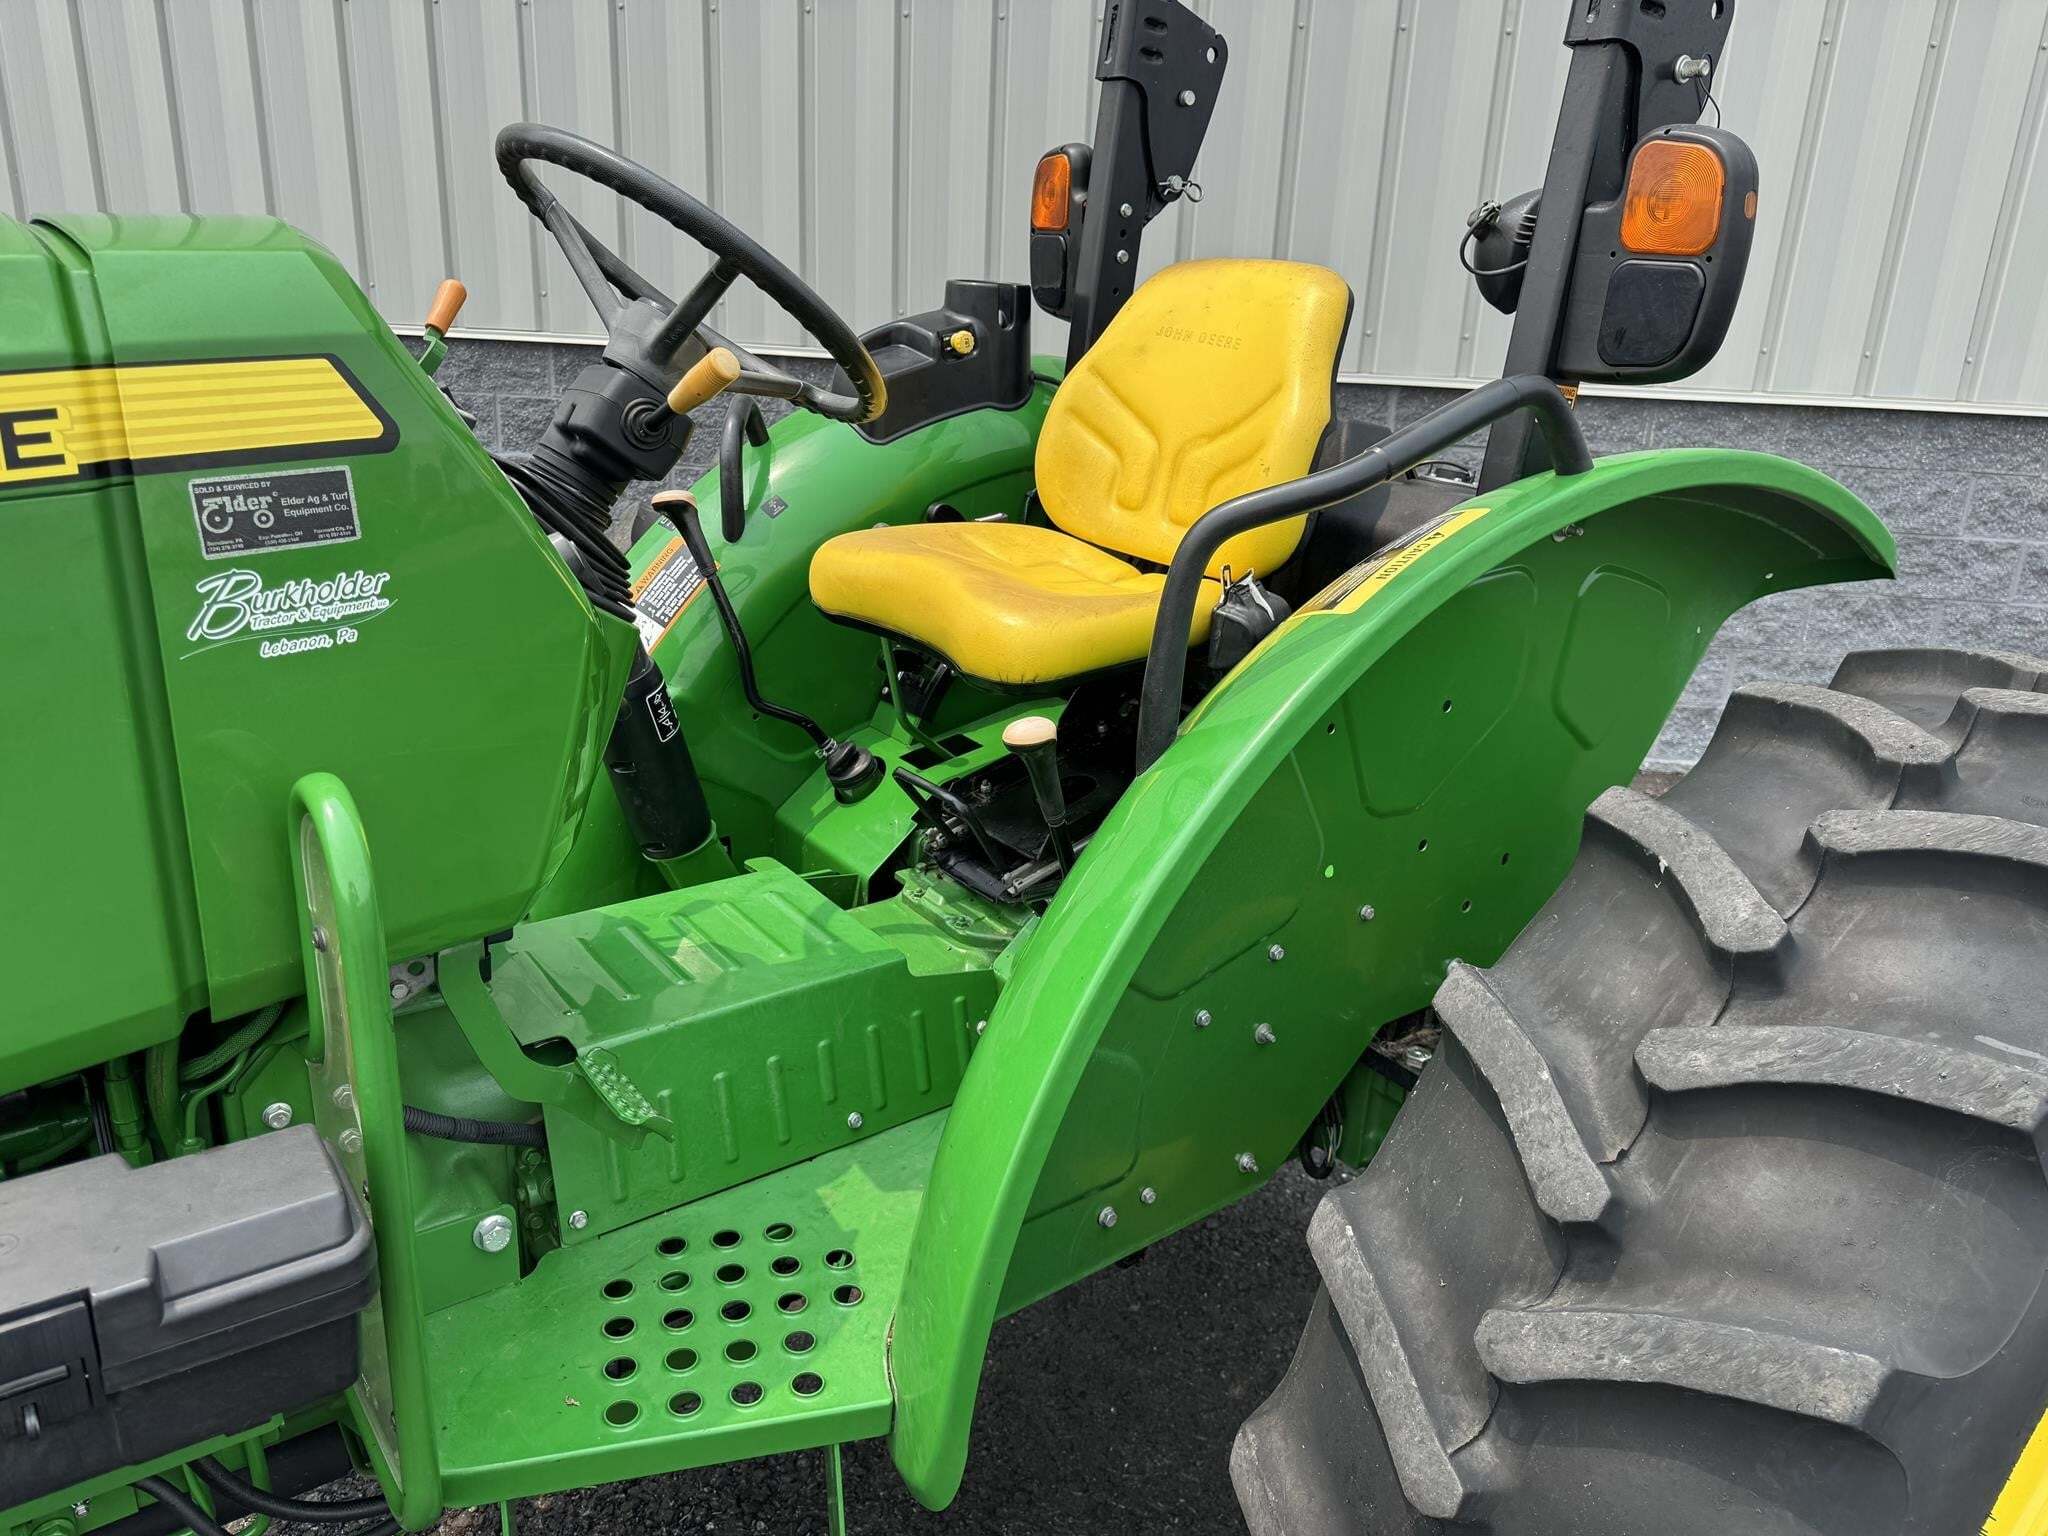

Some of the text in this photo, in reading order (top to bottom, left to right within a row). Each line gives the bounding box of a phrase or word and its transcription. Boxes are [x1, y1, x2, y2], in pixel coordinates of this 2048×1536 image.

[1199, 332, 1242, 350] DEERE
[193, 485, 215, 494] SOLD
[223, 482, 260, 492] SERVICED
[281, 491, 348, 507] Elder Ag & Turf
[284, 503, 350, 518] Equipment Co.
[643, 546, 674, 586] WARNING
[1376, 541, 1431, 580] CAUTION
[187, 568, 391, 642] Burkholder
[251, 611, 296, 630] Tractor
[297, 607, 309, 622] &
[311, 598, 377, 622] Equipment
[260, 627, 358, 659] Lebanon, Pa
